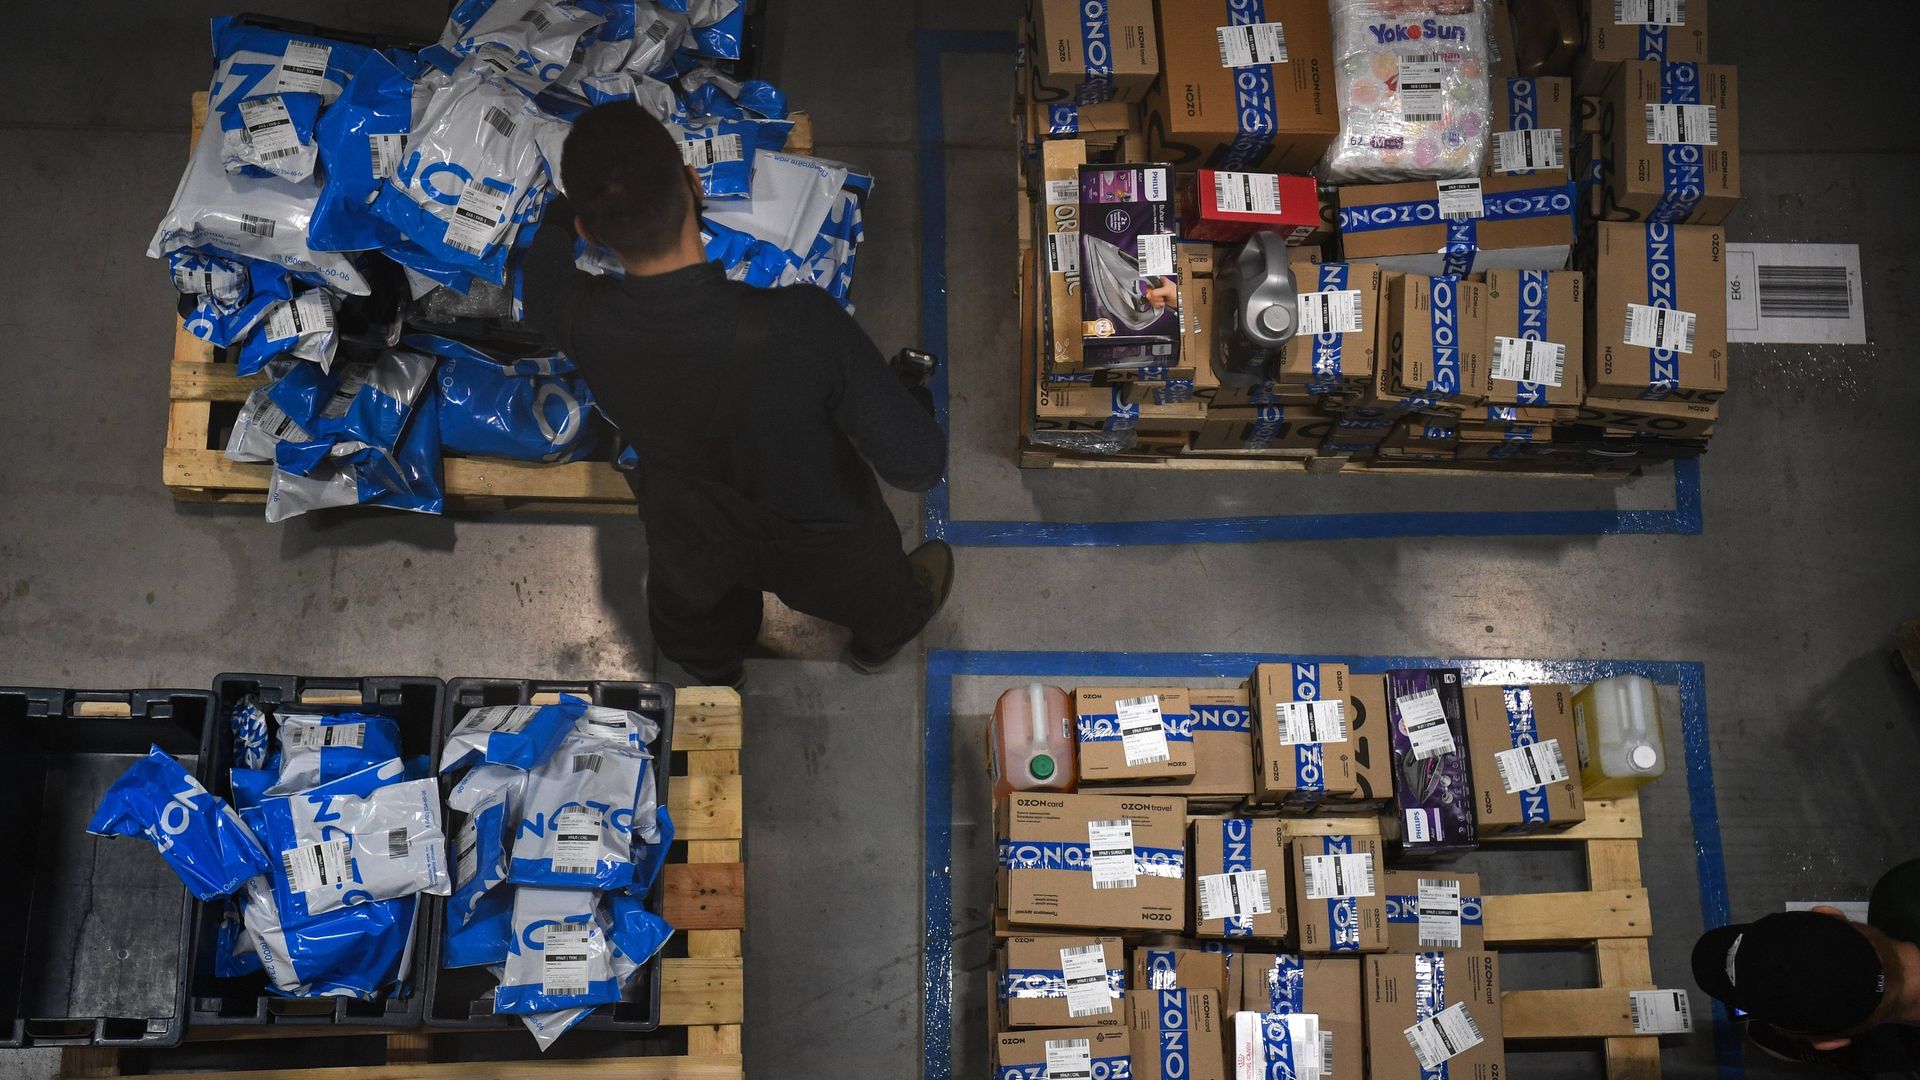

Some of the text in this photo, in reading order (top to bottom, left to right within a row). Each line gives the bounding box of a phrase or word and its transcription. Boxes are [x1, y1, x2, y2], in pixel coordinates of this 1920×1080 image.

[1311, 59, 1320, 91] OZON
[1185, 84, 1196, 117] OZON
[1350, 137, 1363, 146] 62
[1018, 799, 1064, 808] OZON card
[1121, 803, 1150, 811] OZON
[223, 877, 239, 891] Ozon
[1142, 912, 1172, 921] OZON
[260, 941, 274, 964] (800)
[1002, 1037, 1025, 1045] OZON
